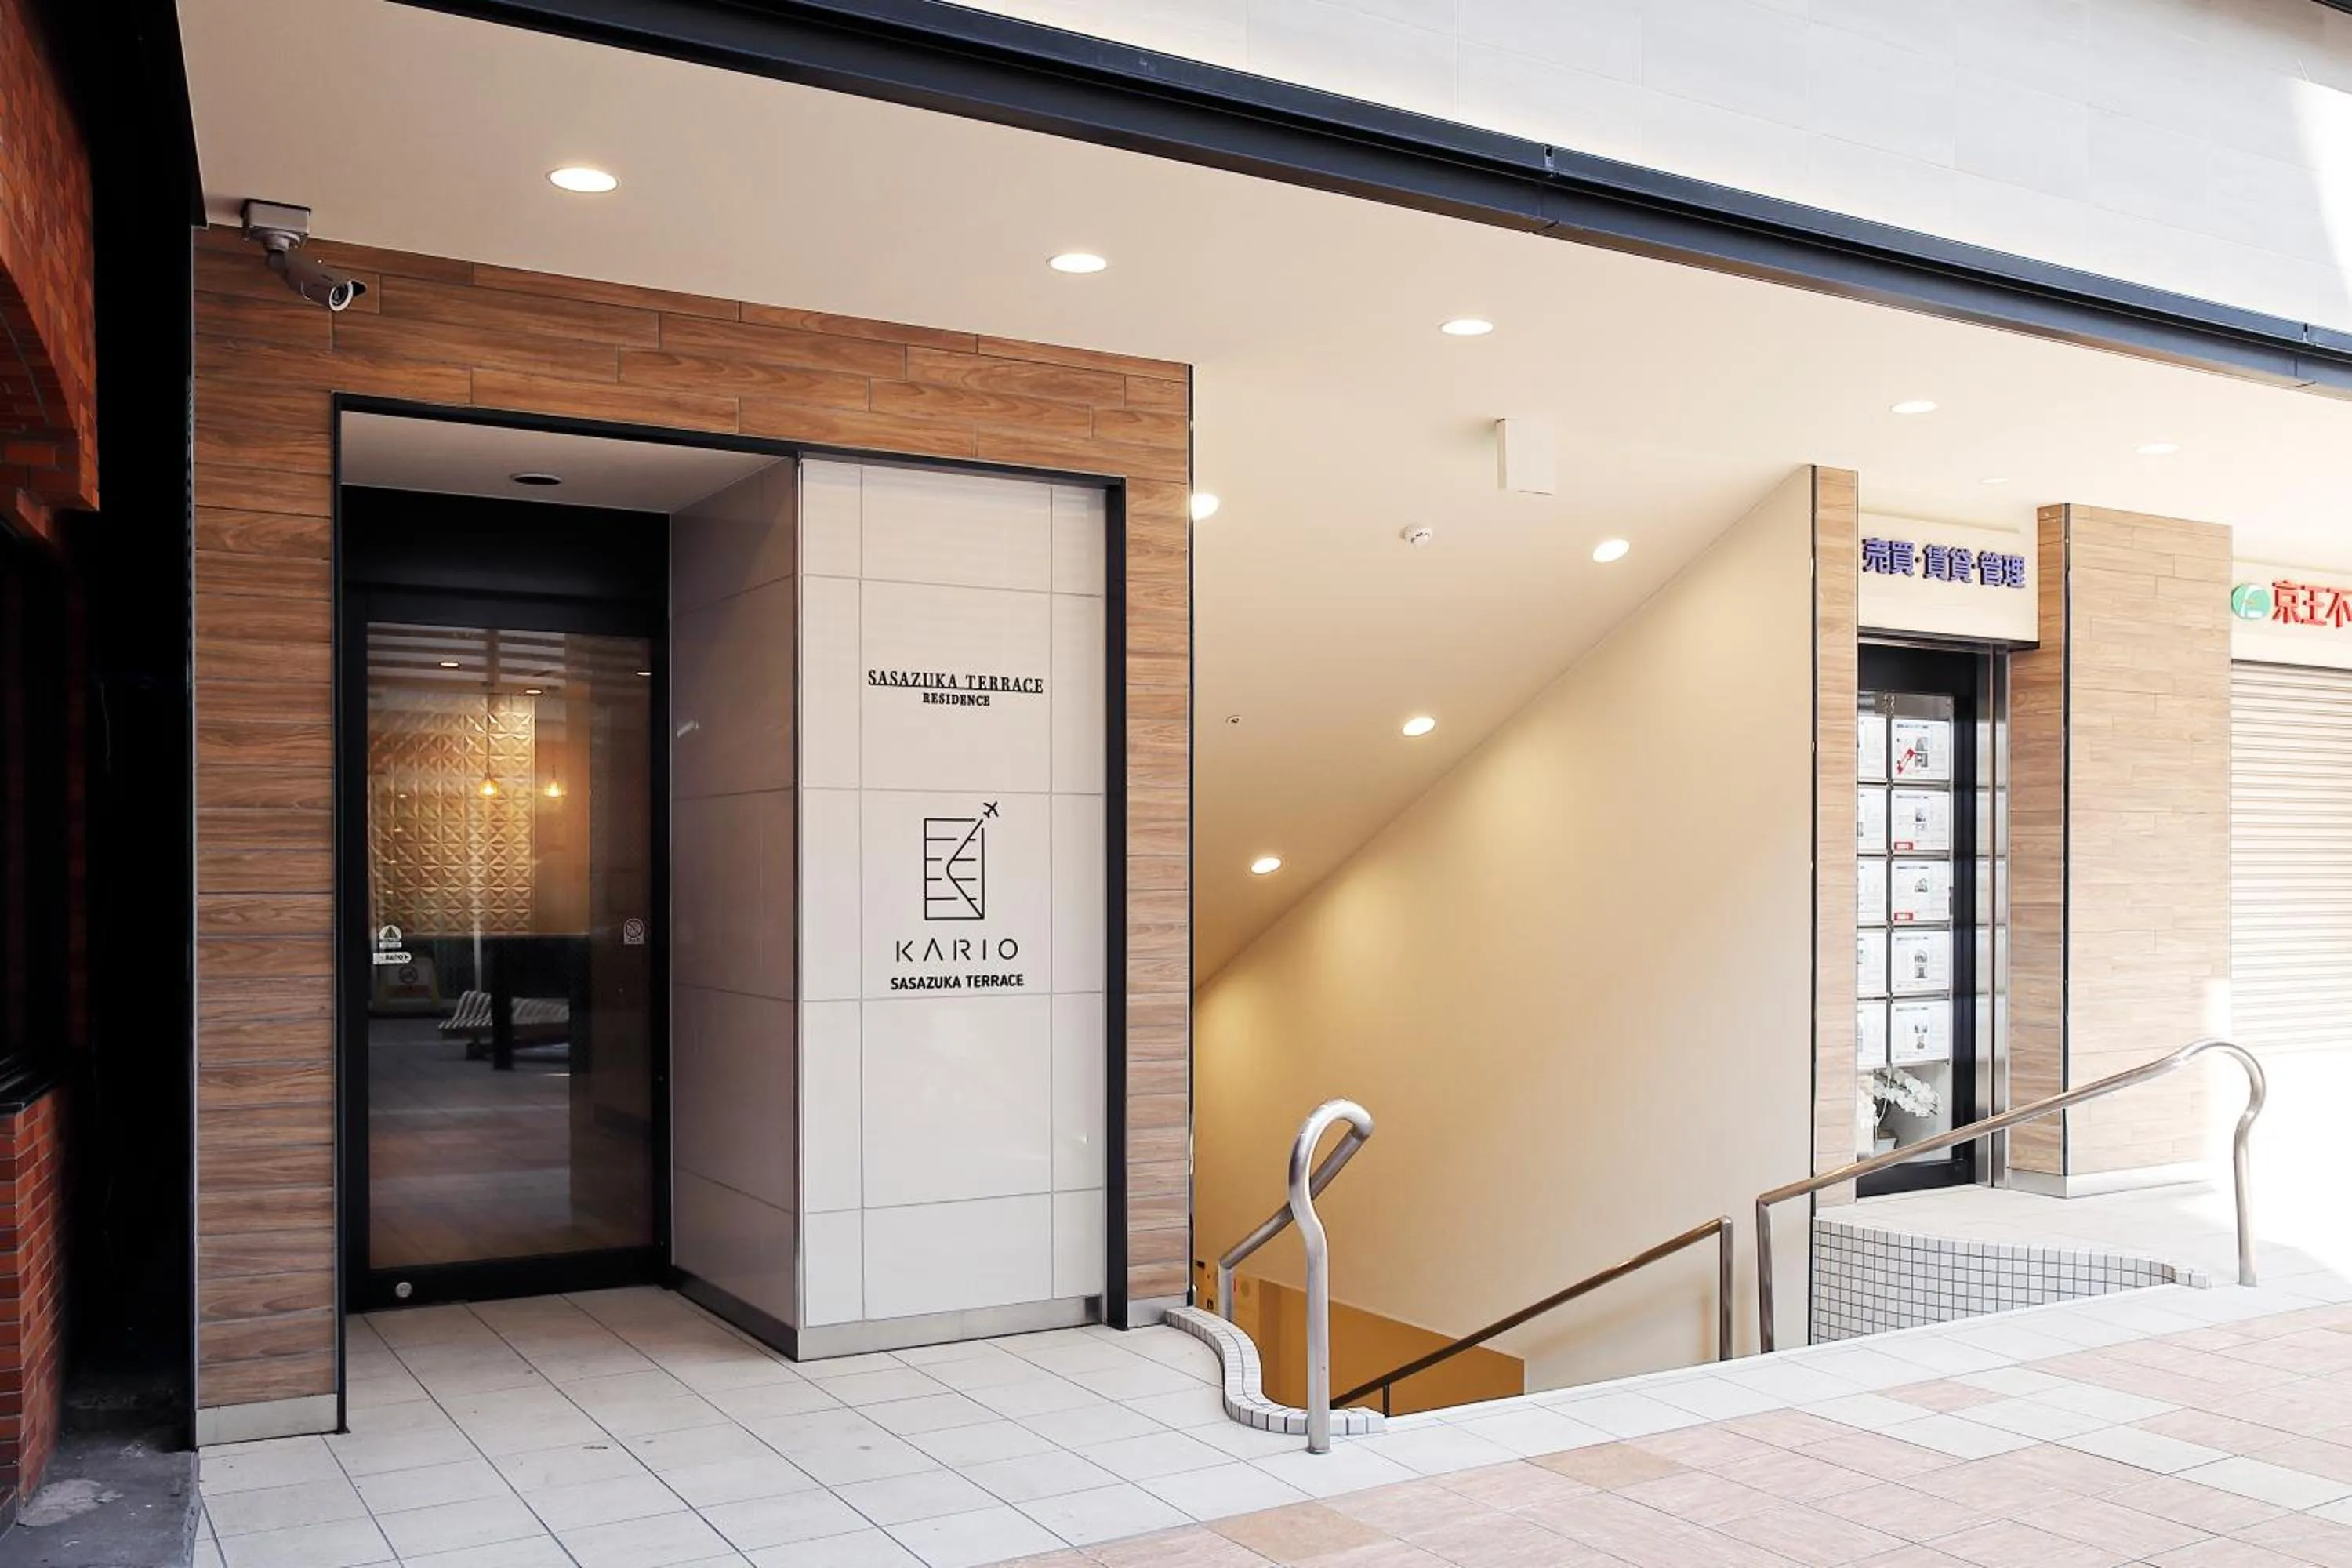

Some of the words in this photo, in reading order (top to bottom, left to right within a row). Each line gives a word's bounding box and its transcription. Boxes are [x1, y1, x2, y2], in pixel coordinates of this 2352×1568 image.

[2272, 579, 2352, 628] 京王不
[868, 670, 957, 689] SASAZUKA
[966, 674, 1044, 694] TERRACE
[923, 692, 990, 706] RESIDENCE
[896, 938, 1018, 962] KARIO
[890, 975, 962, 990] SASAZUKA
[966, 973, 1025, 988] TERRACE
